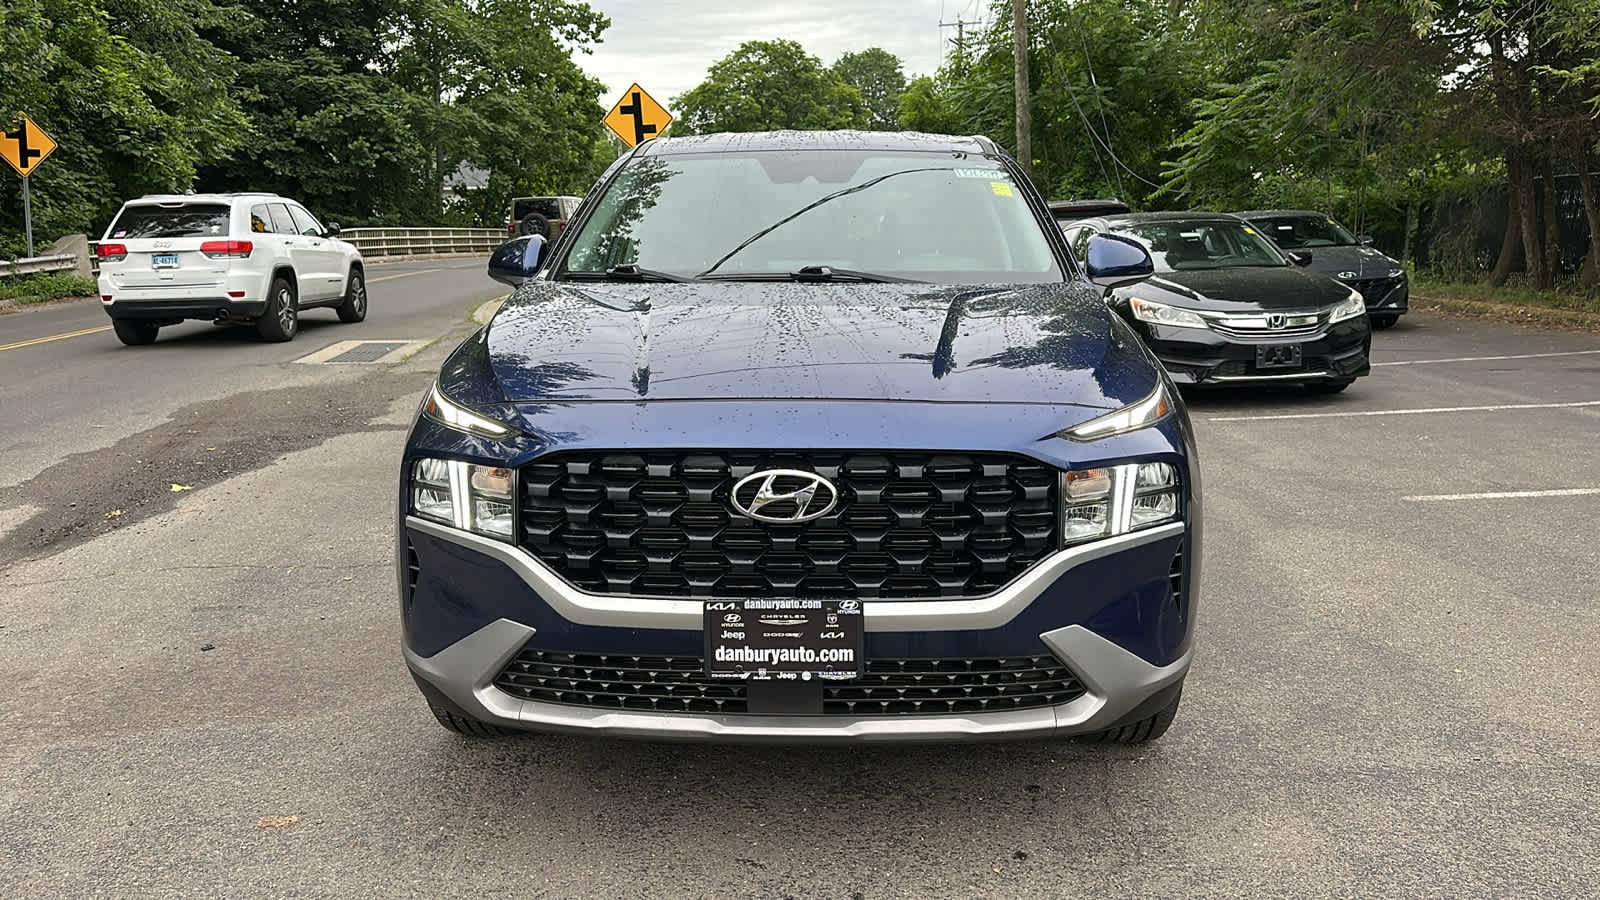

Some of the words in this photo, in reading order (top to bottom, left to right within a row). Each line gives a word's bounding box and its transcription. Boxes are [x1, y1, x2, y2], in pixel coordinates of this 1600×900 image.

[744, 598, 822, 611] danburyauto.com
[720, 630, 745, 641] Jeep
[715, 644, 854, 665] danburyauto.com
[776, 671, 797, 681] Jeep
